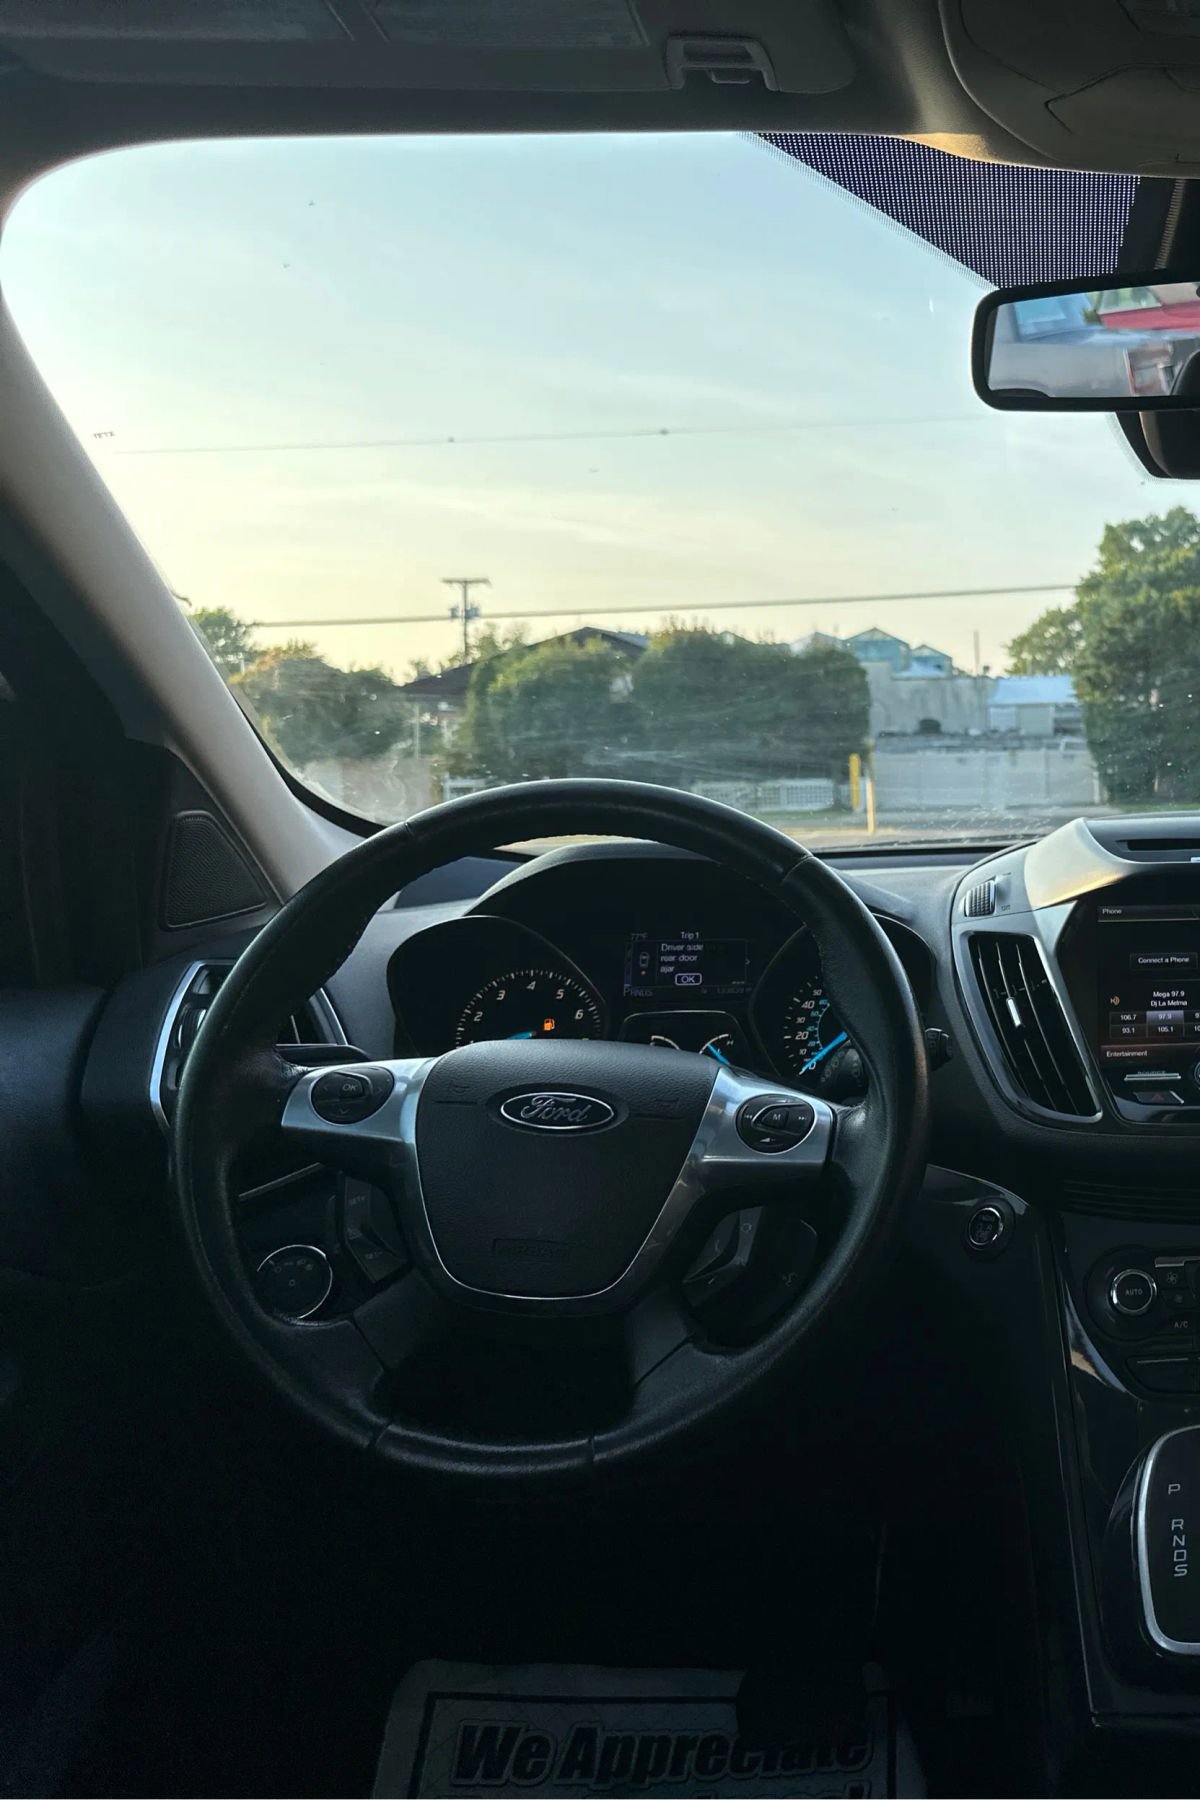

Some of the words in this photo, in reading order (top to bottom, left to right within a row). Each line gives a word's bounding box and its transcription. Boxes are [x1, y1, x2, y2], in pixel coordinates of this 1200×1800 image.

[680, 931, 694, 940] Trip
[661, 943, 685, 951] Driver
[686, 943, 704, 951] side
[677, 954, 699, 962] door
[1137, 956, 1164, 964] Connect
[1170, 956, 1190, 964] Phone
[660, 966, 675, 974] ajar
[680, 975, 696, 983] OK
[526, 981, 537, 991] 4
[496, 989, 507, 1001] 3
[555, 988, 565, 1000] 5
[1152, 991, 1170, 999] Mega
[1171, 990, 1185, 998] 97.9
[801, 1000, 815, 1009] 40
[473, 1011, 483, 1022] 2
[574, 1009, 584, 1020] 6
[795, 1031, 809, 1040] 20
[1106, 1049, 1148, 1058] Entertainment
[520, 1095, 592, 1123] Ford
[1125, 1288, 1143, 1296] AUTO
[1174, 1320, 1188, 1328] A/C
[1168, 1483, 1181, 1495] P
[1171, 1518, 1184, 1531] R
[1172, 1534, 1186, 1547] N
[1173, 1549, 1187, 1562] D
[1173, 1564, 1188, 1577] S
[460, 1724, 554, 1781] We
